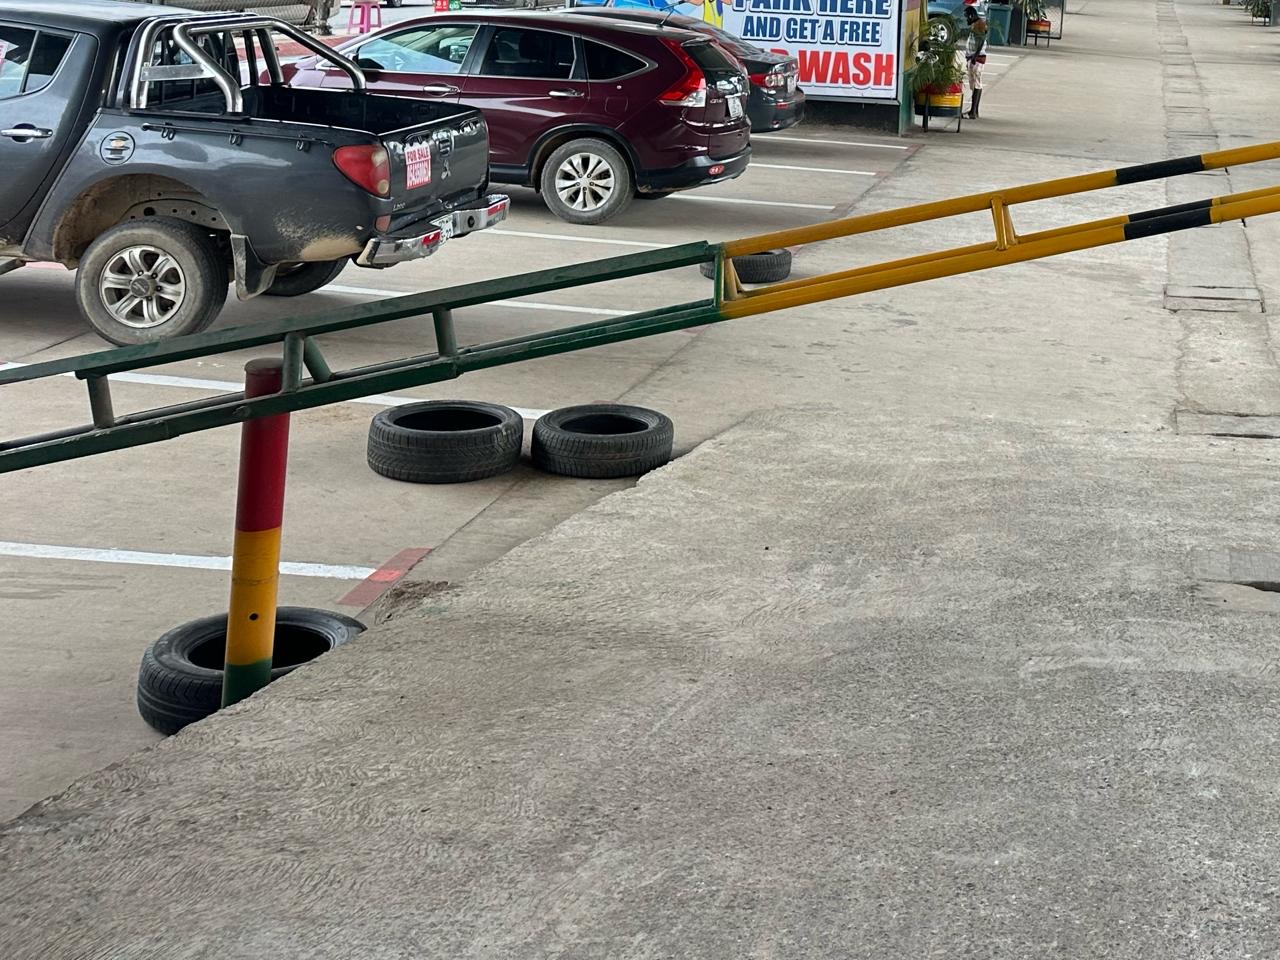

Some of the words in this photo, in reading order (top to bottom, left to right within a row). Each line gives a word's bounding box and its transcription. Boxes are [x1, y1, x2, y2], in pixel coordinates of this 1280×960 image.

[742, 16, 781, 39] AND
[786, 18, 820, 41] GET
[822, 20, 834, 41] A
[839, 20, 880, 43] FREE
[799, 50, 894, 87] WASH
[407, 150, 417, 163] FOR
[417, 147, 429, 161] SALE
